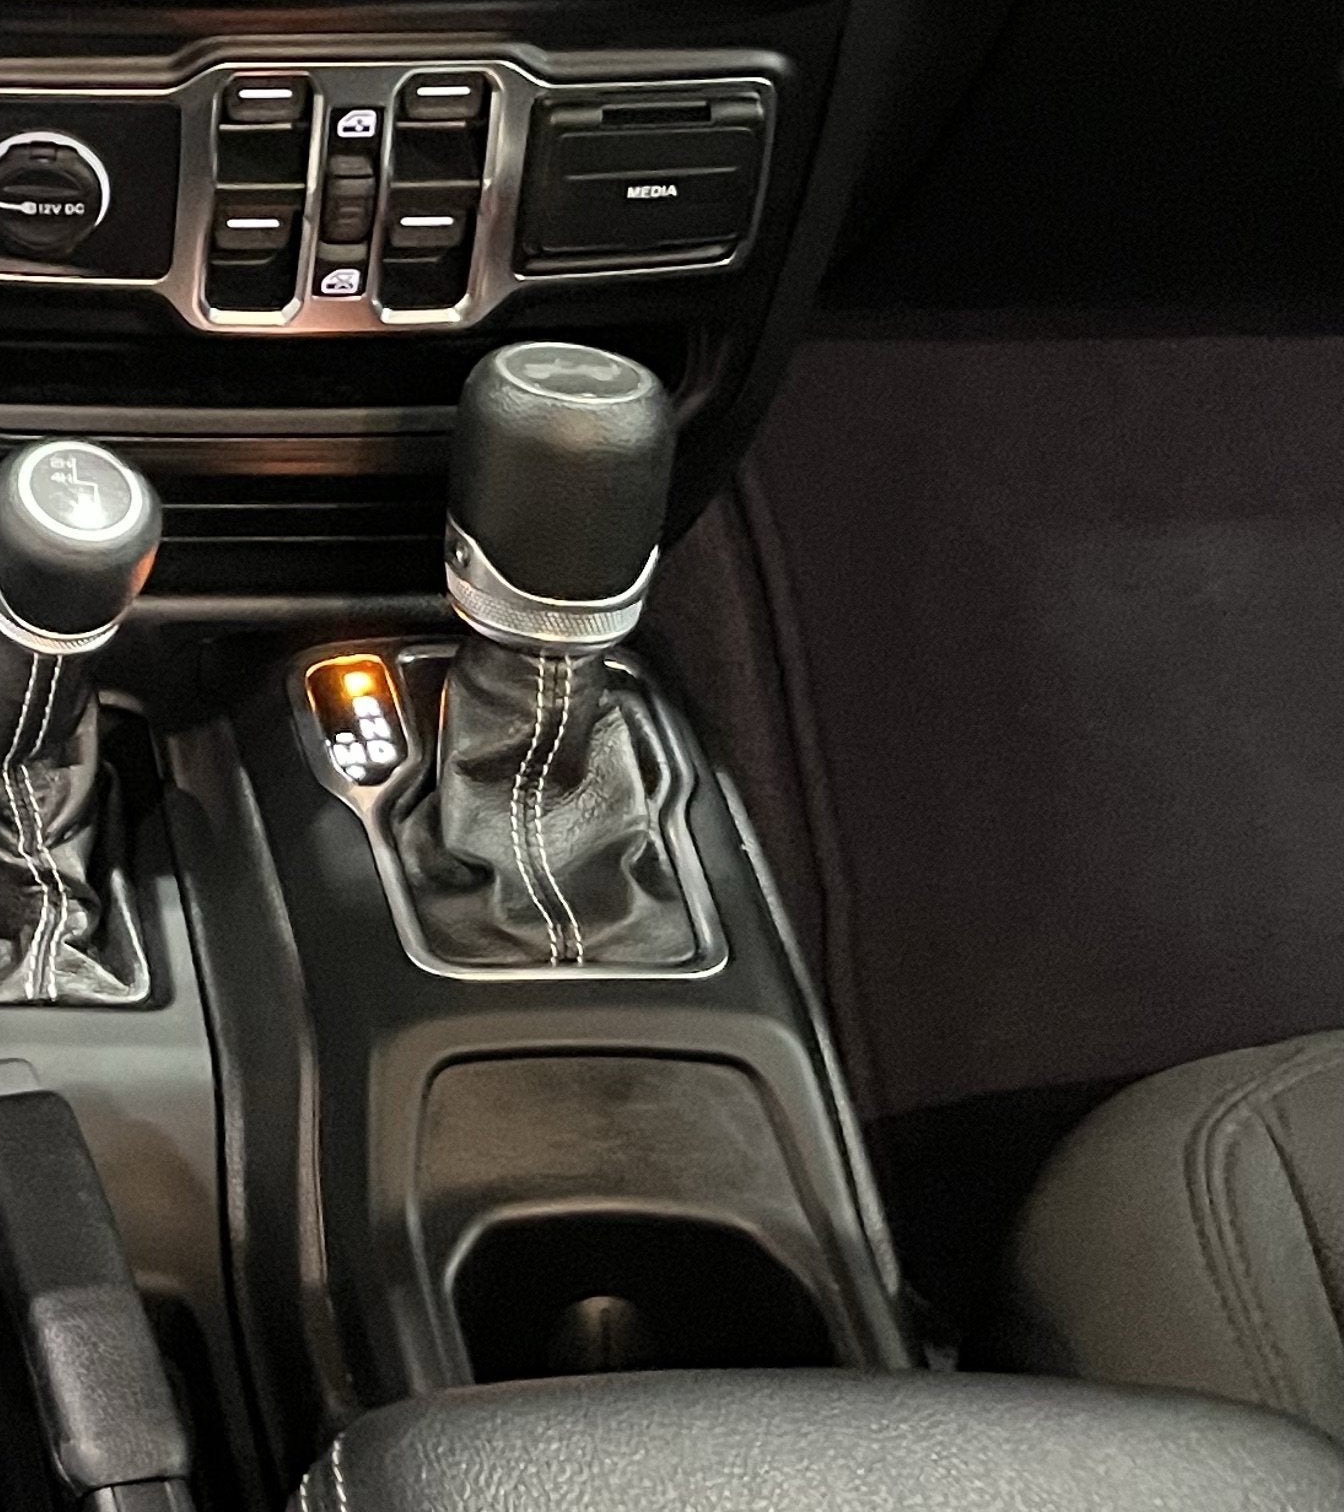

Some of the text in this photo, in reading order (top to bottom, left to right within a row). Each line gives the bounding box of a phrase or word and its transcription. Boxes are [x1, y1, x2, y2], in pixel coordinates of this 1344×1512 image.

[626, 182, 678, 200] MEDIA
[38, 201, 85, 216] 12V DC
